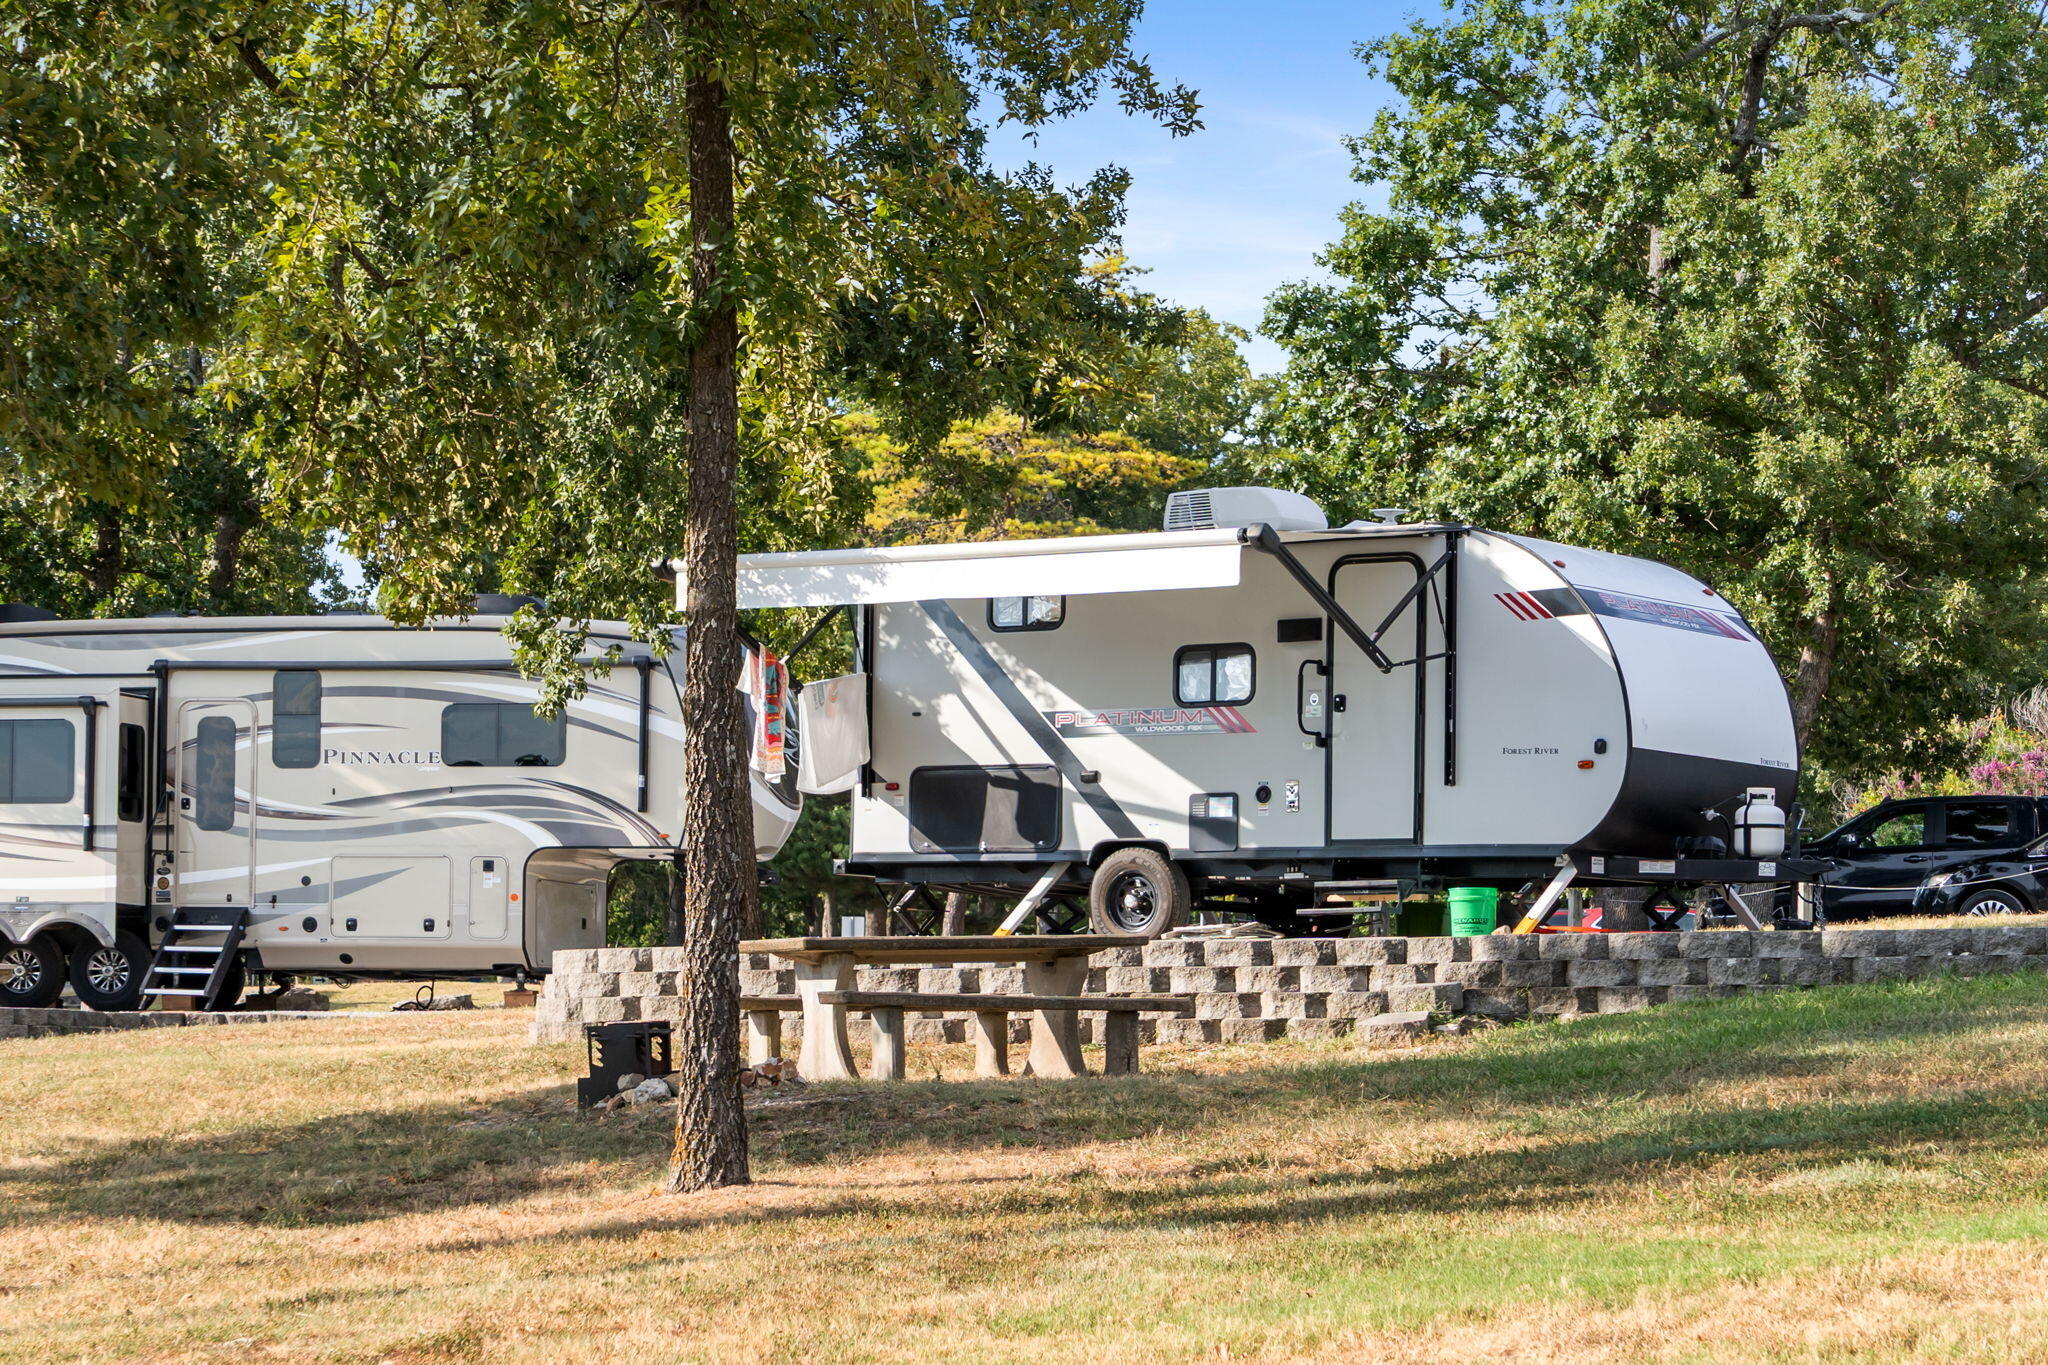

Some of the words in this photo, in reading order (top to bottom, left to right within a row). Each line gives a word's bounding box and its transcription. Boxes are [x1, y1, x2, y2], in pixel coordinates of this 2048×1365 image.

[1055, 709, 1203, 728] PLATINUM
[323, 748, 441, 765] PINNACLE
[1502, 747, 1533, 755] FOREST
[1534, 747, 1559, 755] RIVER
